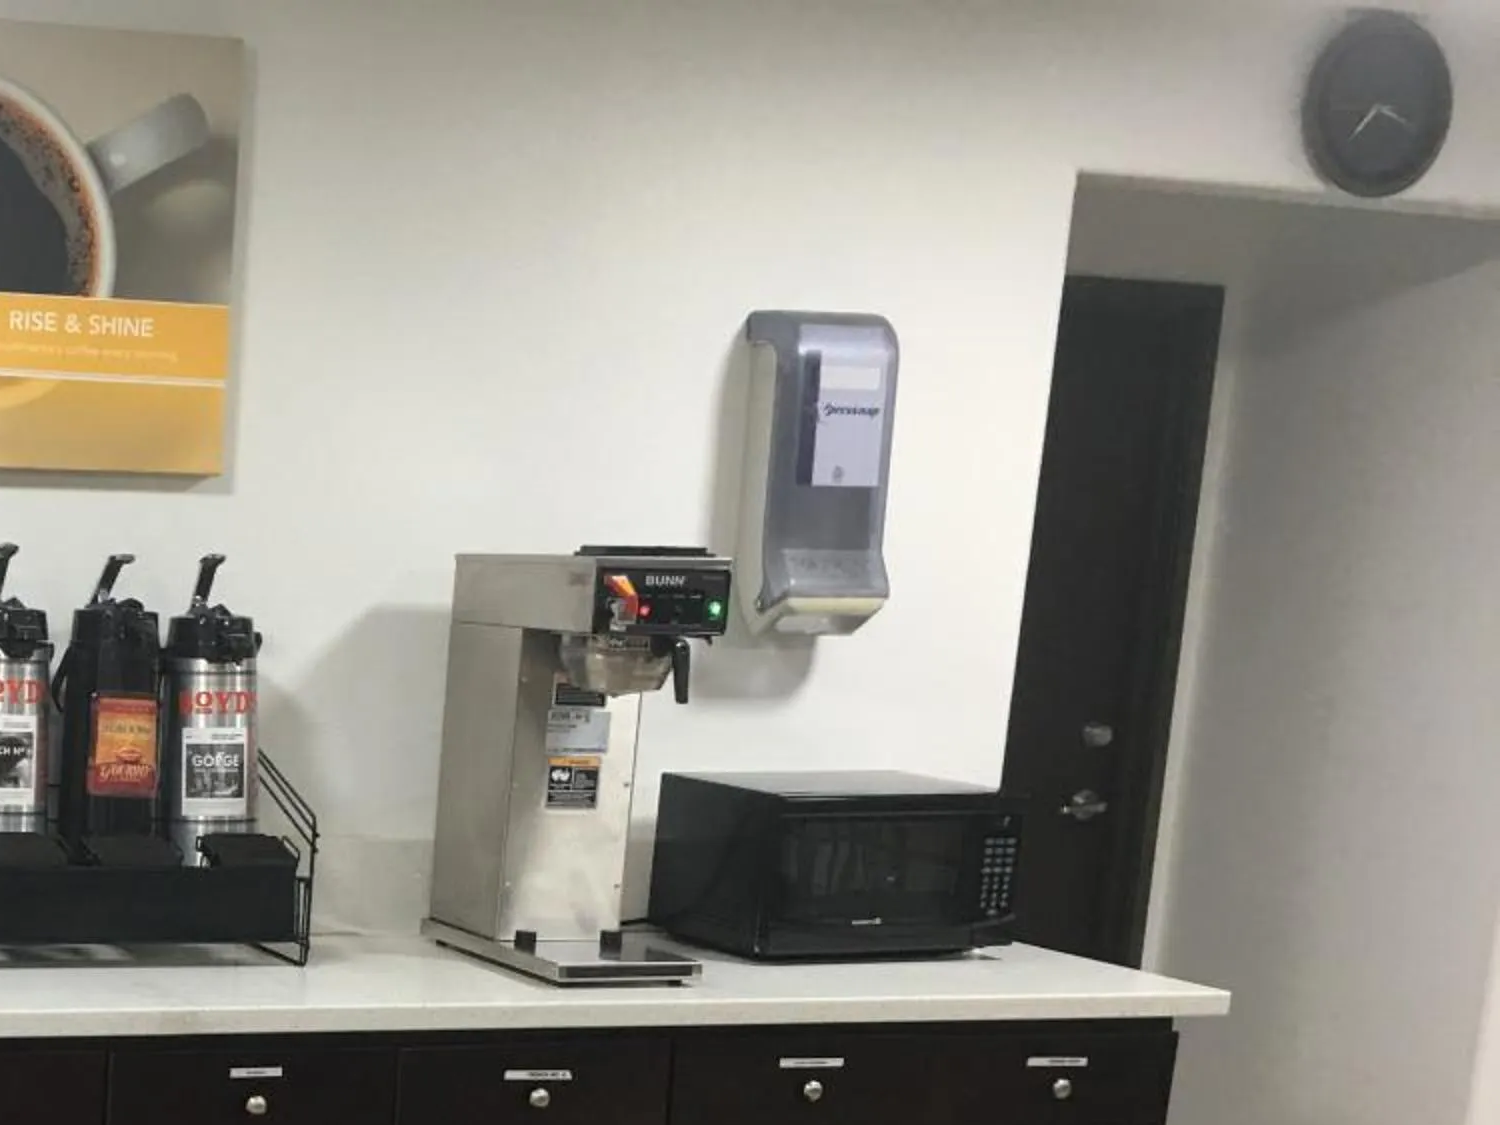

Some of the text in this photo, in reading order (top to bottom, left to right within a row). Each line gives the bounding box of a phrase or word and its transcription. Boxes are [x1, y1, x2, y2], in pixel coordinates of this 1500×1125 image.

[9, 310, 155, 338] RISE & SHINE
[645, 574, 686, 587] BUNN
